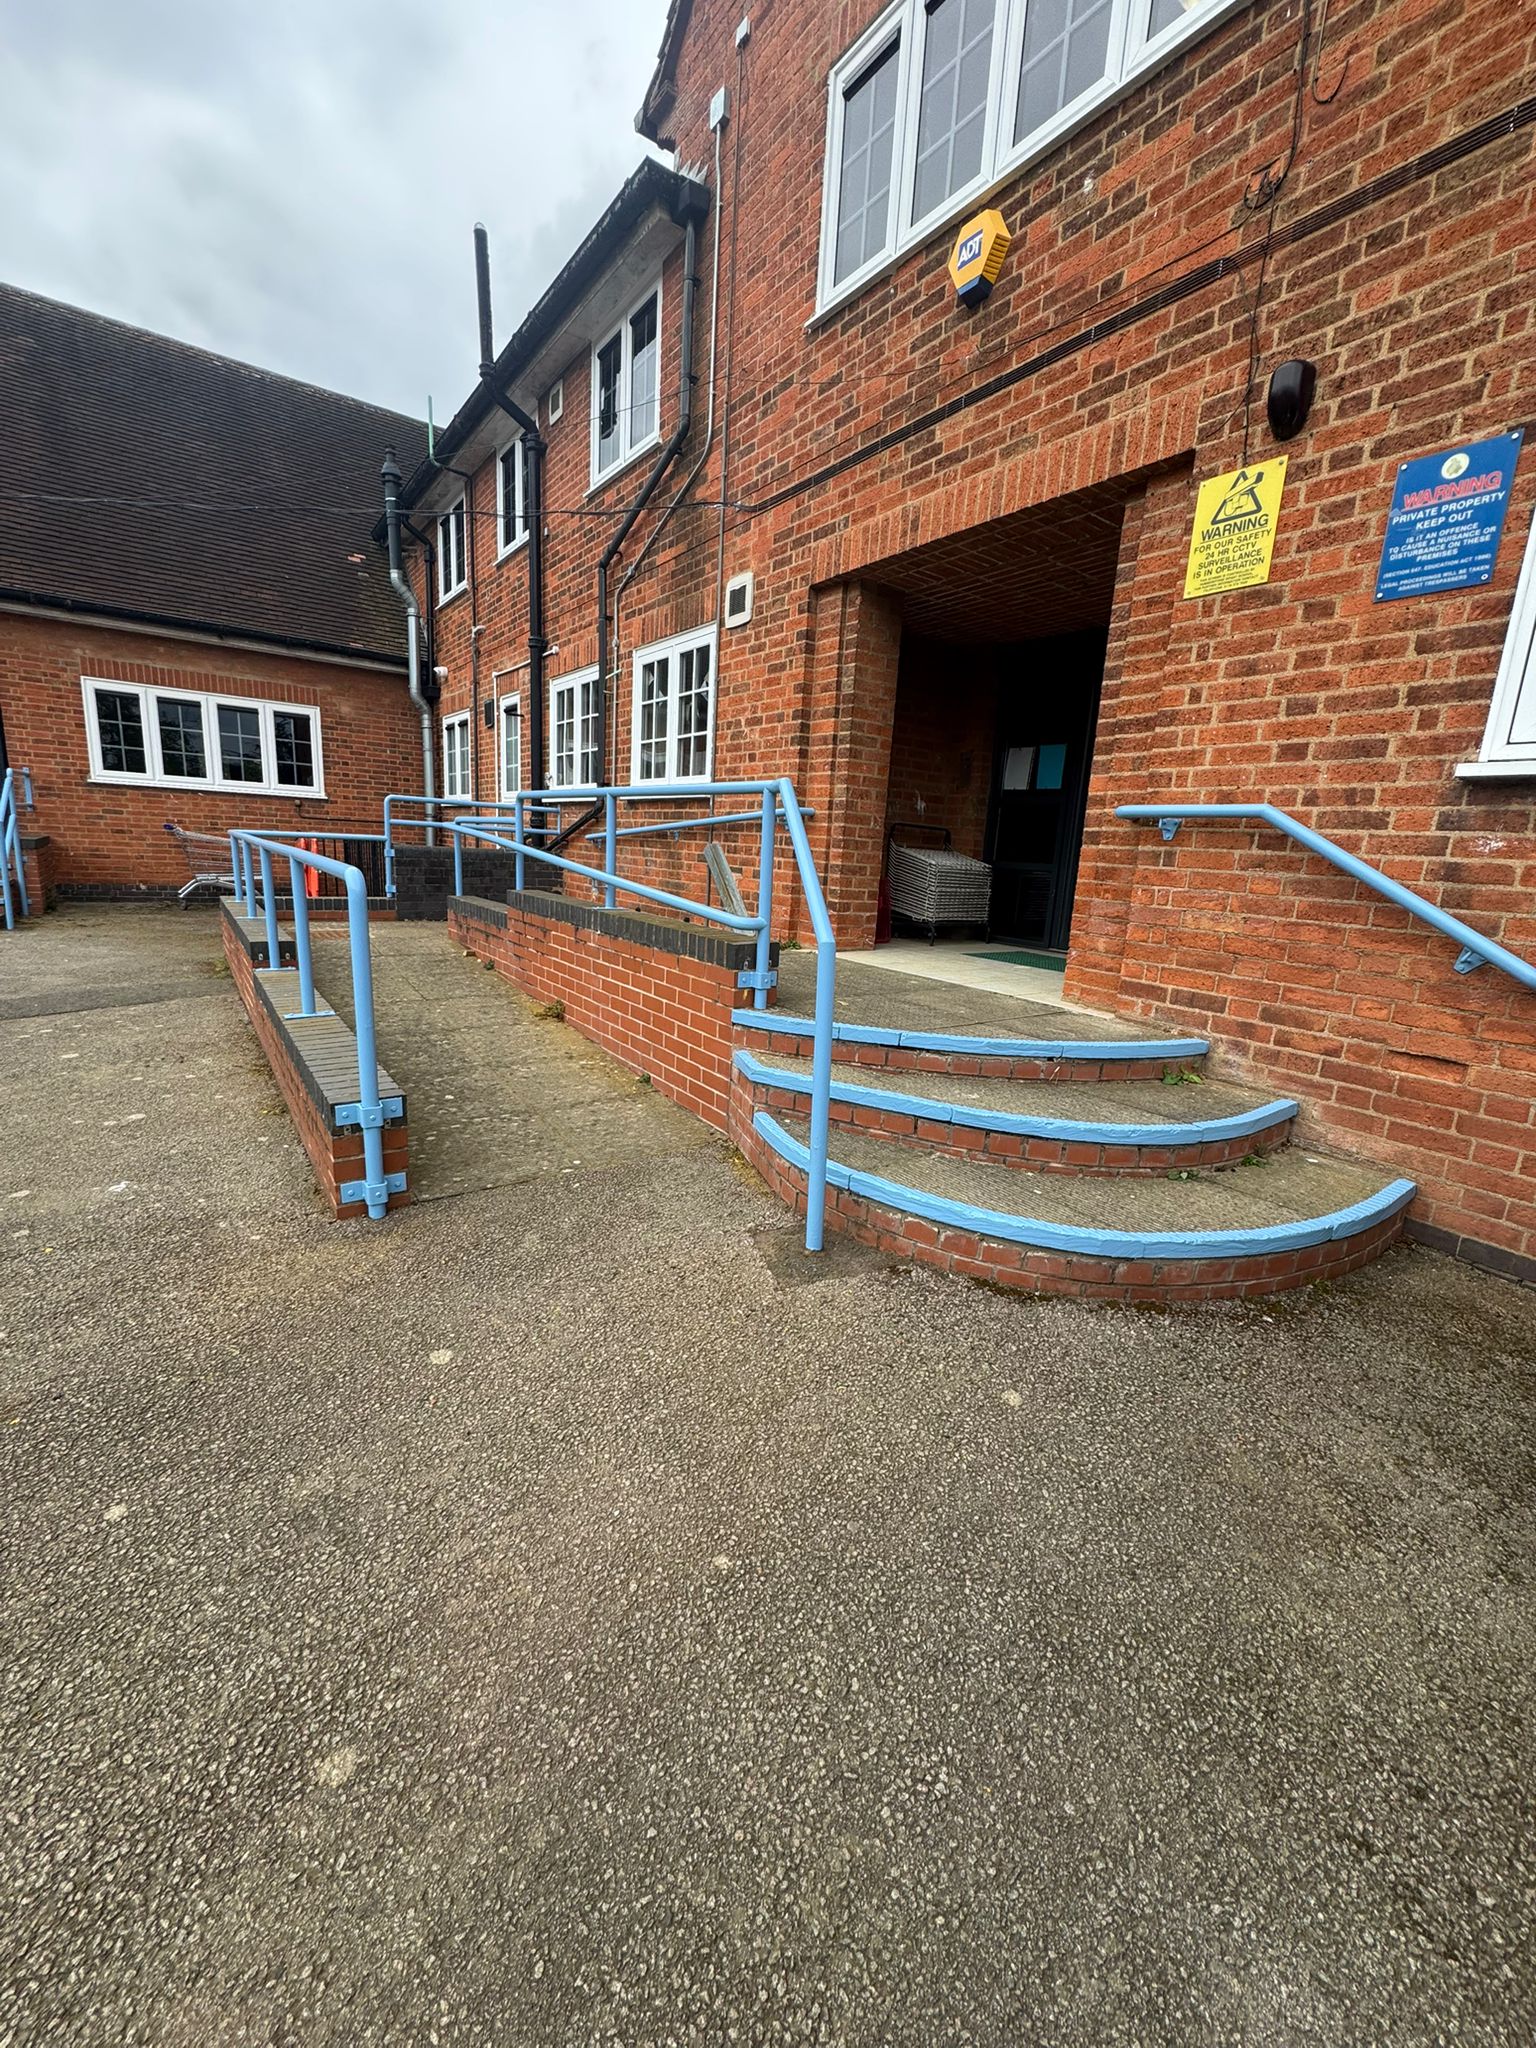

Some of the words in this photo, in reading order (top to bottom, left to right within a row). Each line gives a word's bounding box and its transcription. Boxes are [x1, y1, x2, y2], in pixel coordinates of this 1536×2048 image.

[958, 232, 984, 266] ADT
[1403, 471, 1502, 510] WARNING
[1392, 507, 1438, 525] PRIVATE
[1441, 491, 1505, 513] PROPERTY
[1415, 516, 1445, 530] KEEP
[1449, 510, 1473, 523] OUT
[1202, 513, 1269, 541] WARNING
[1425, 531, 1437, 540] AN
[1439, 522, 1478, 536] OFFENCE
[1194, 543, 1211, 555] FOR
[1214, 537, 1233, 549] OUR
[1236, 528, 1272, 544] SAFETY
[1205, 551, 1214, 560] 24
[1218, 547, 1229, 557] HR
[1232, 541, 1257, 553] CCTV
[1389, 546, 1399, 554] TO
[1401, 540, 1427, 551] CAUSE
[1437, 529, 1481, 543] NUISANCE
[1483, 526, 1496, 534] OR
[1390, 544, 1446, 561] DISTURBANCE
[1448, 540, 1461, 548] ON
[1463, 534, 1491, 545] THESE
[1198, 548, 1262, 570] SURVEILLANCE
[1204, 568, 1212, 577] IN
[1215, 556, 1264, 574] OPERATION
[1416, 548, 1458, 562] PREMISES
[1460, 556, 1473, 564] ACT
